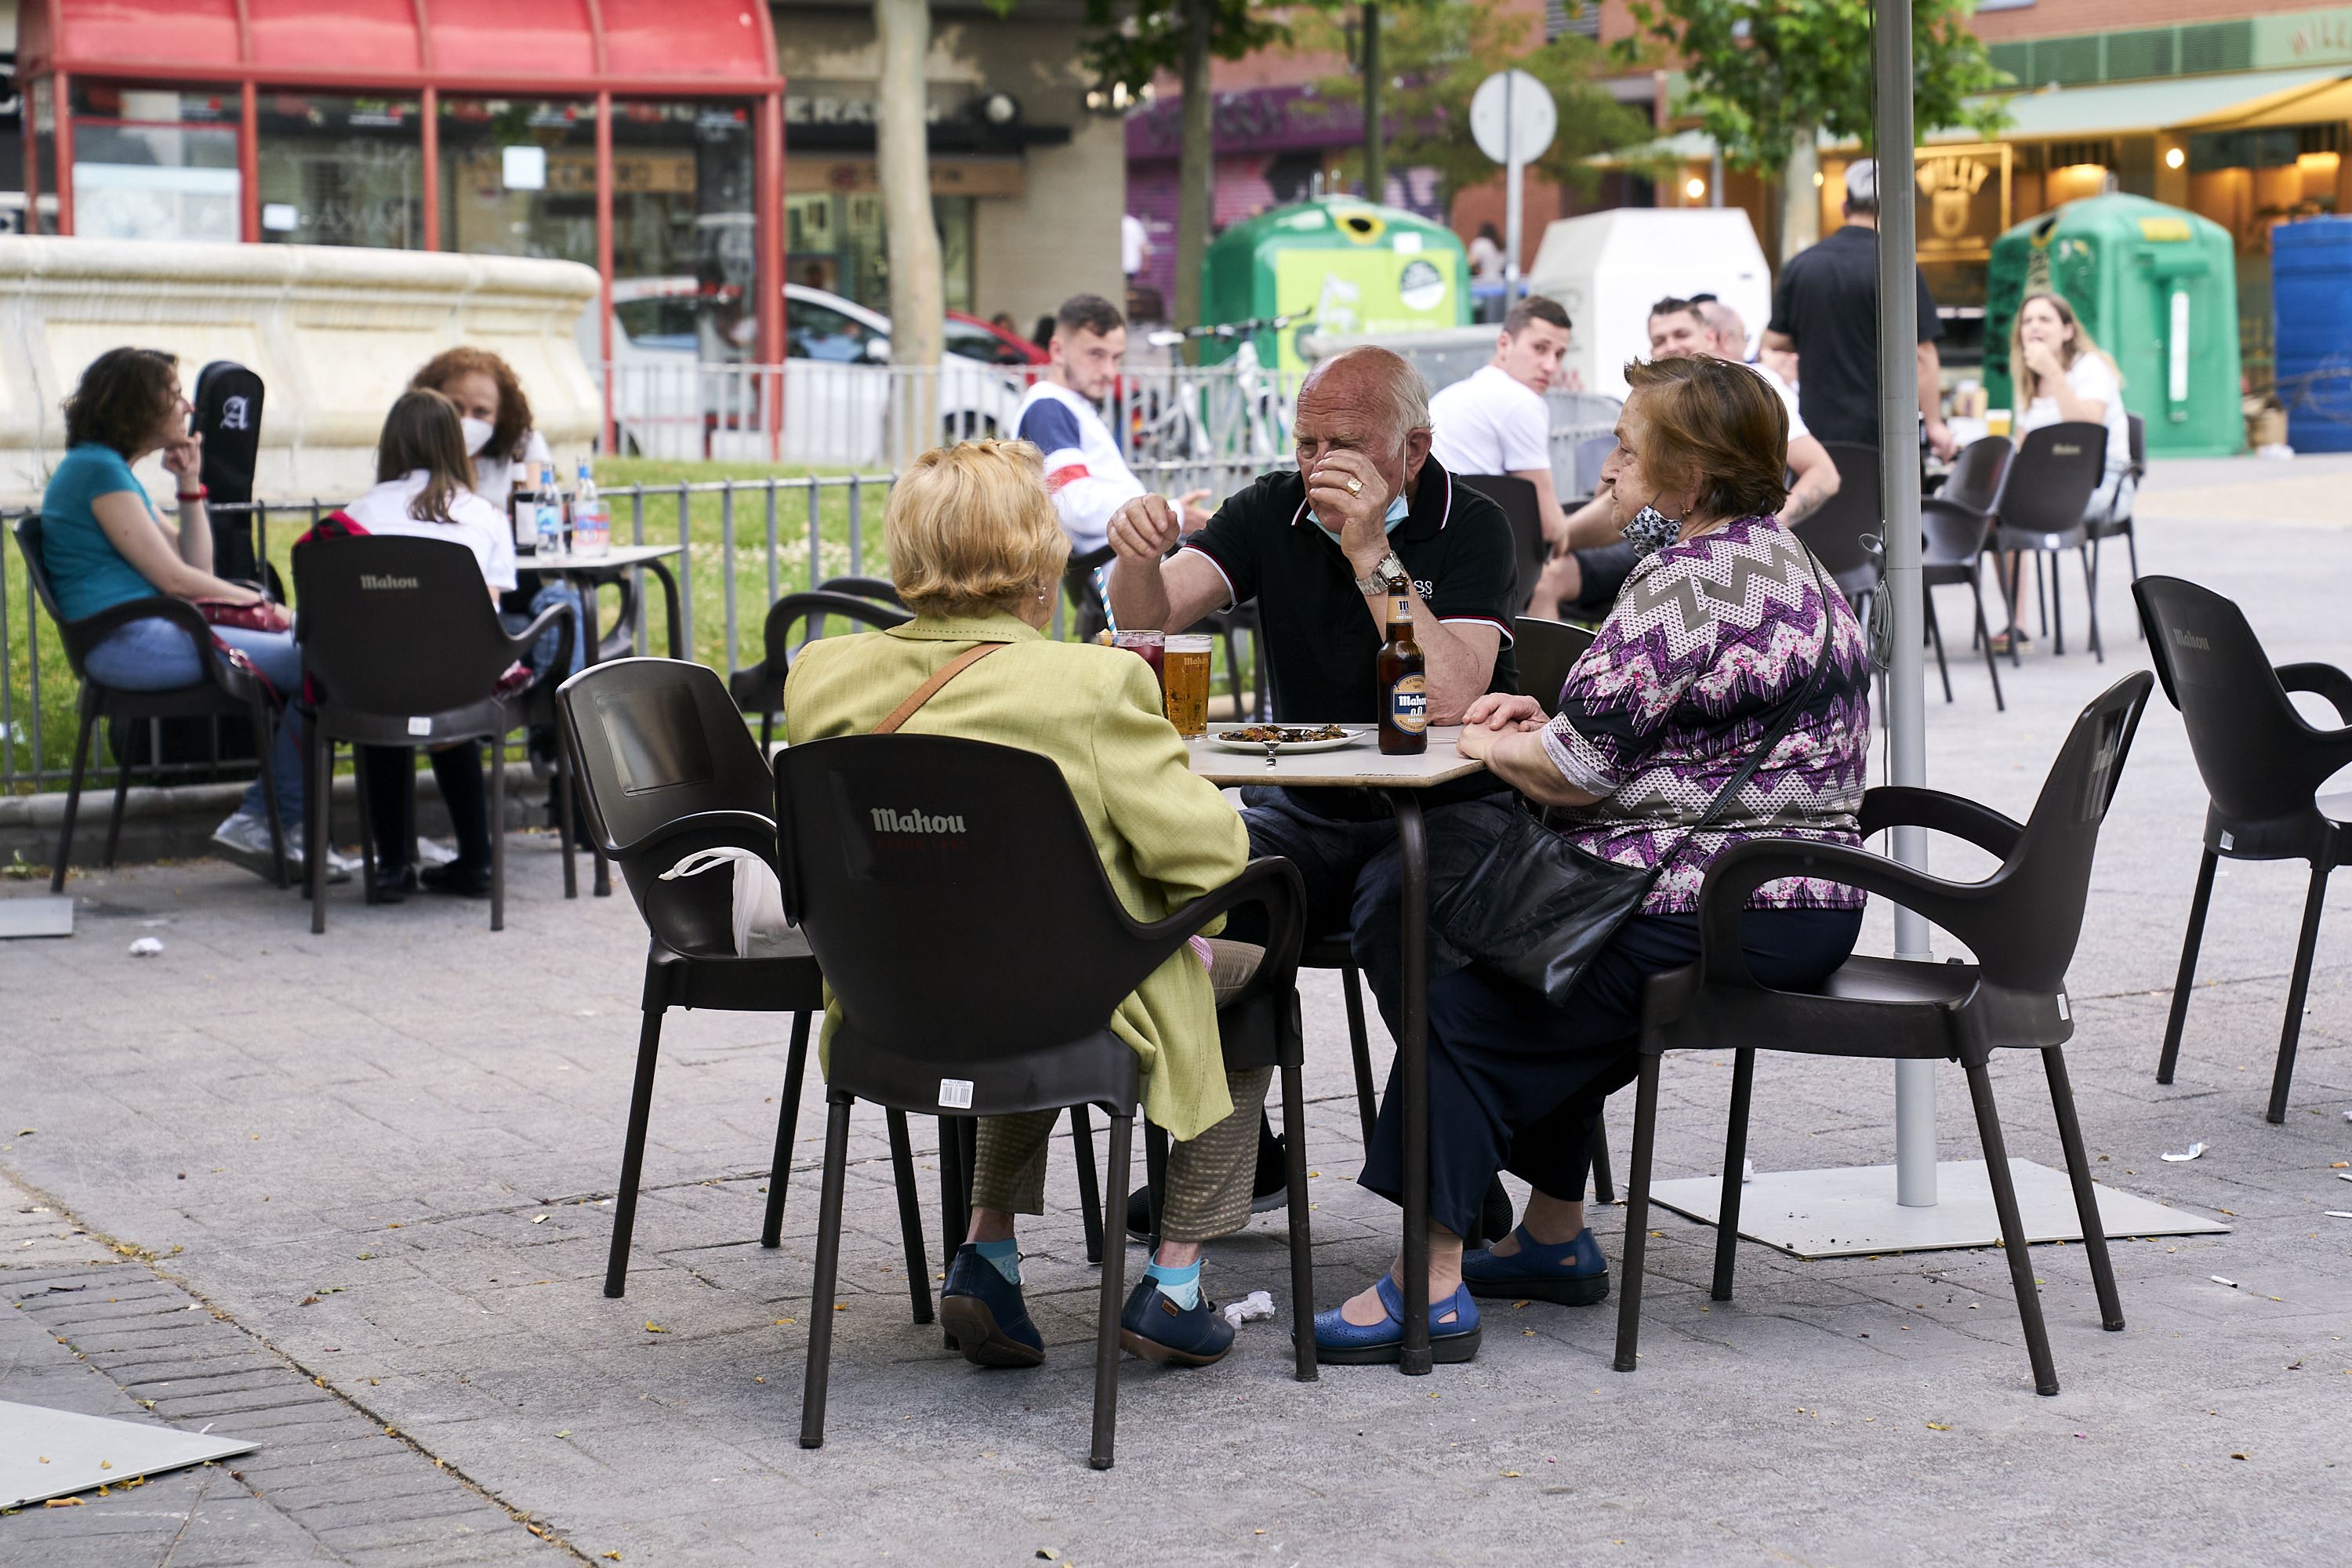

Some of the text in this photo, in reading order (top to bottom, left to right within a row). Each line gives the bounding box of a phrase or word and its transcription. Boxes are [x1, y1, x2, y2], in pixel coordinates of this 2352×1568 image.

[220, 395, 249, 430] A
[360, 573, 419, 590] Mahou
[1414, 580, 1433, 594] SS
[2172, 627, 2211, 651] Mahou
[869, 808, 967, 833] Mahou
